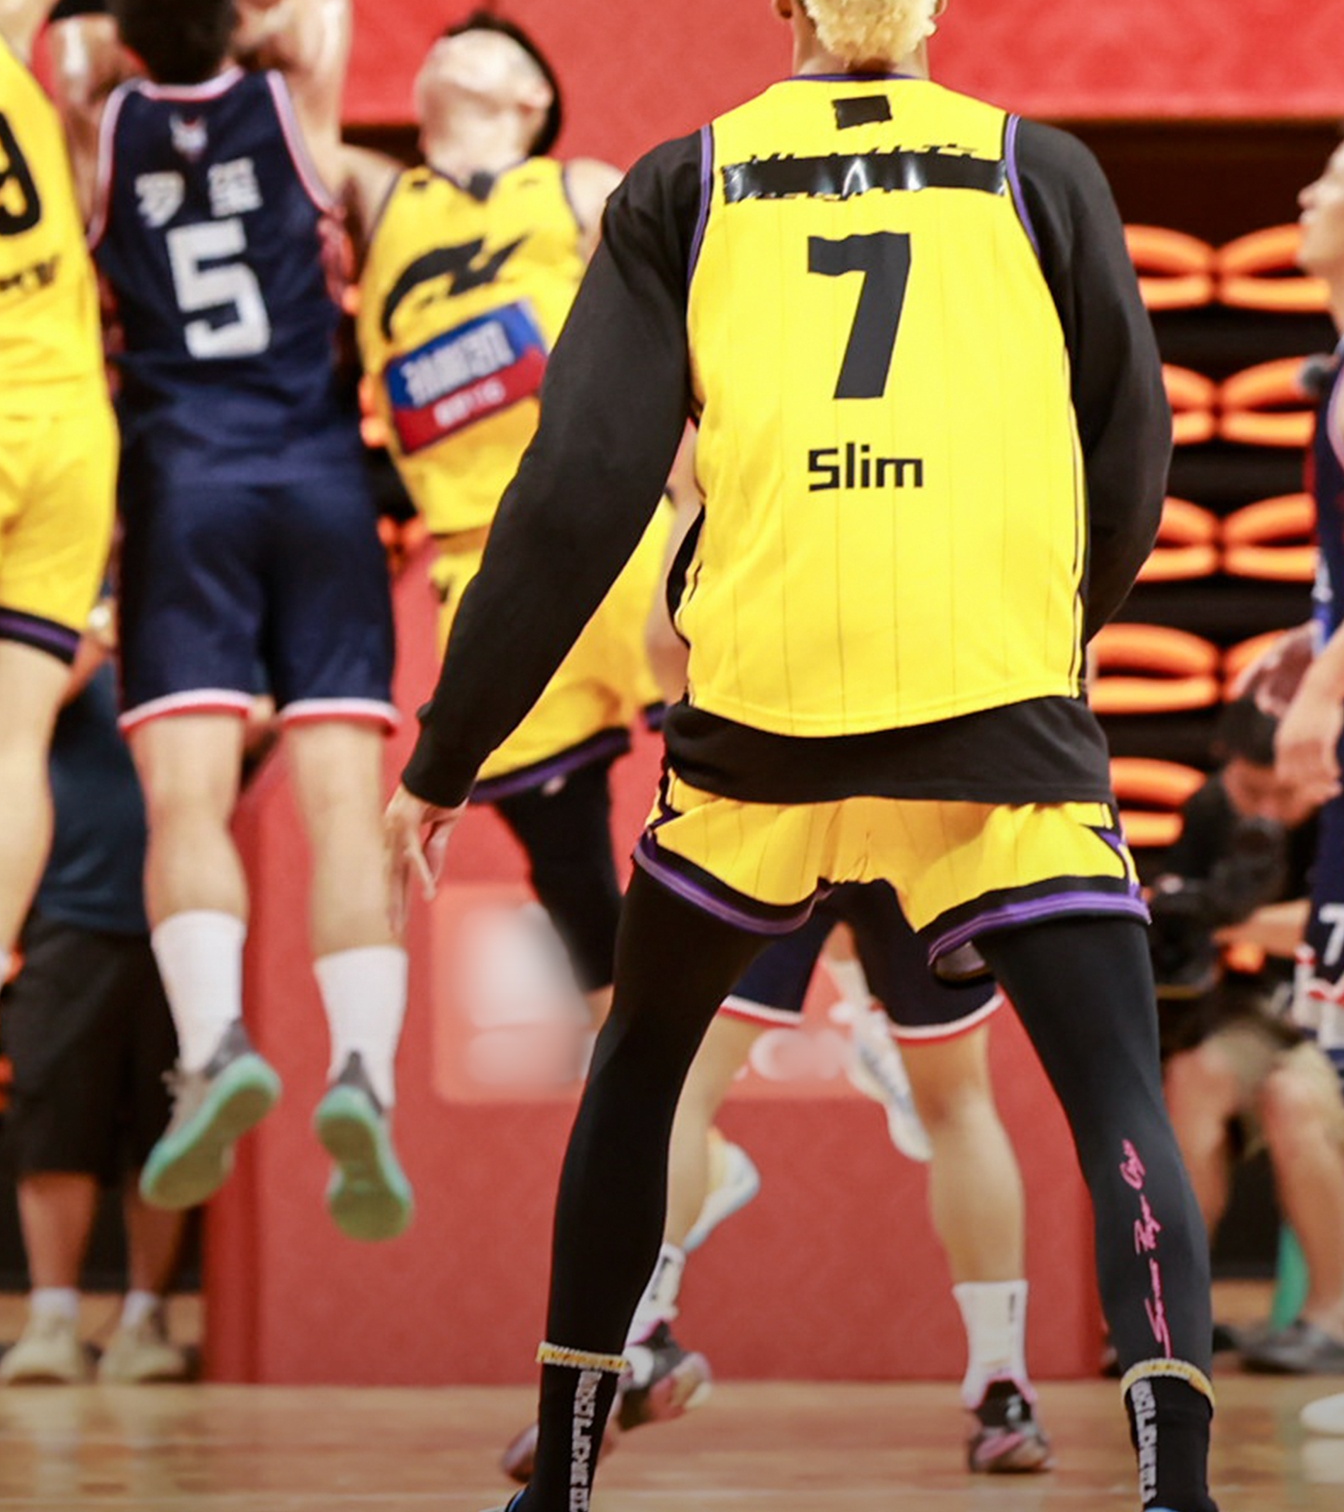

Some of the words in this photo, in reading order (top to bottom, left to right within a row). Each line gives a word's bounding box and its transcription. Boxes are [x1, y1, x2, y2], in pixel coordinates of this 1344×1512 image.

[167, 218, 272, 359] 5
[807, 230, 912, 400] 7
[808, 442, 924, 492] Slim
